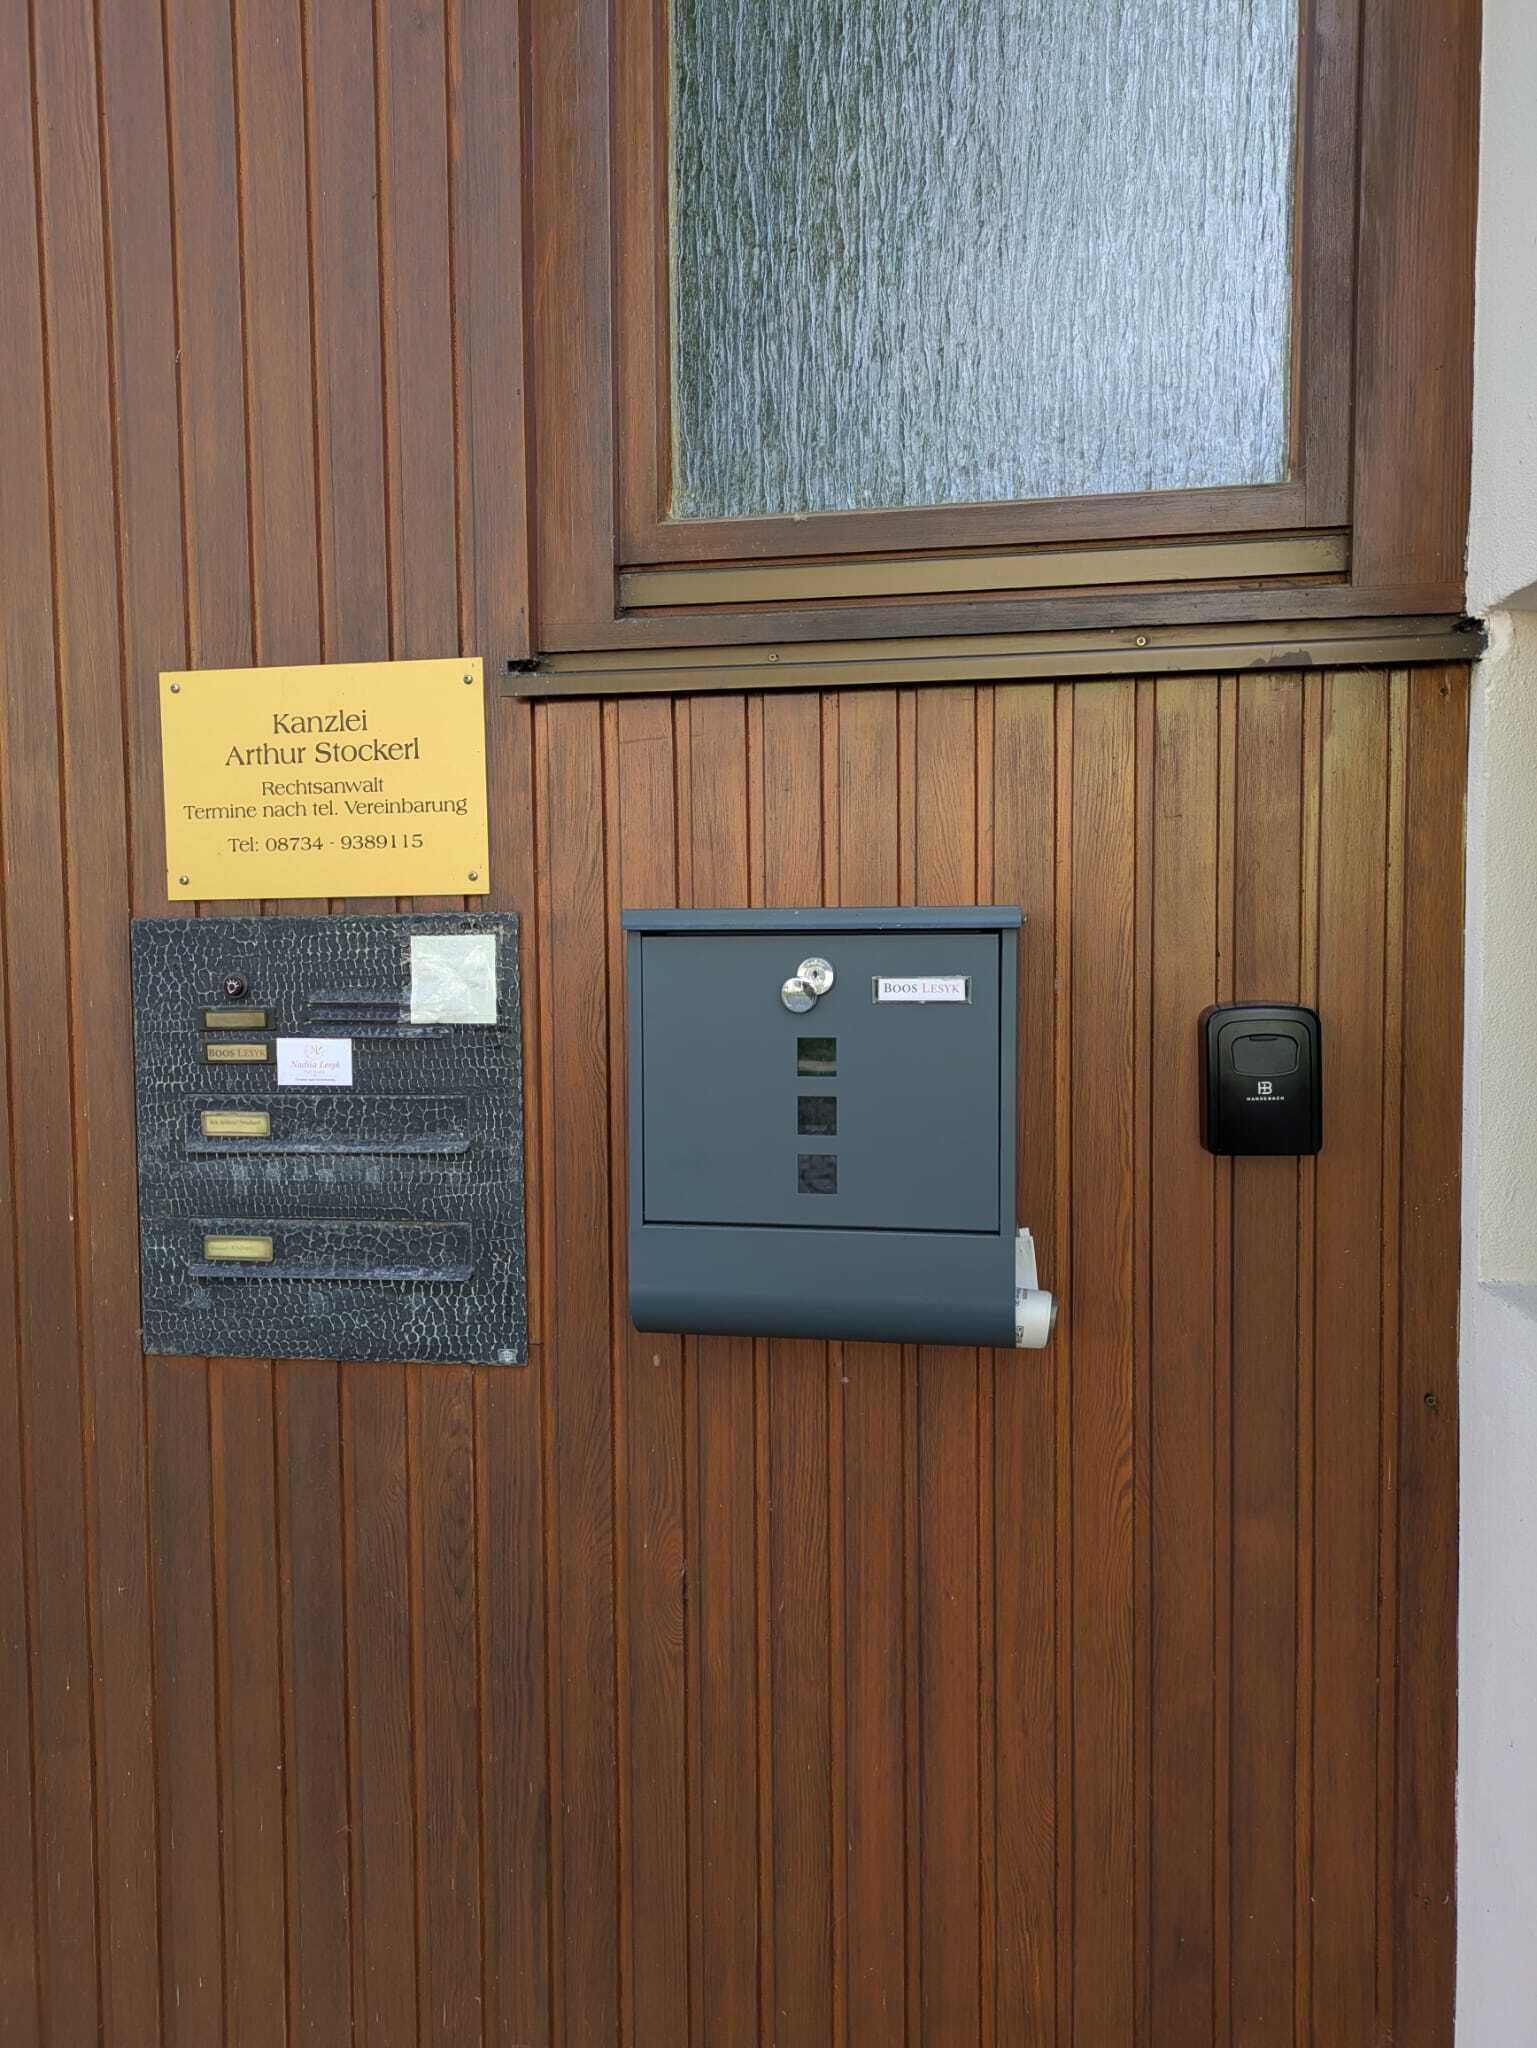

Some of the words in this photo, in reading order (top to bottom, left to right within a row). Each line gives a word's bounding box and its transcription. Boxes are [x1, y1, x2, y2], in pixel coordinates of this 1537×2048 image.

[272, 709, 369, 735] Kanzlei
[225, 743, 306, 766] Arthur
[314, 737, 420, 764] Stockerl
[261, 777, 384, 796] Rechtsanwalt
[183, 804, 257, 820] Termine
[262, 801, 307, 818] nach
[312, 801, 338, 816] tel.
[344, 797, 468, 816] Vereinbarung
[227, 838, 260, 853] Tel:
[265, 837, 324, 852] 08734
[340, 834, 424, 850] 9389115
[883, 982, 918, 994] BOOS
[922, 982, 960, 994] LESYK
[208, 1049, 235, 1059] BOOS
